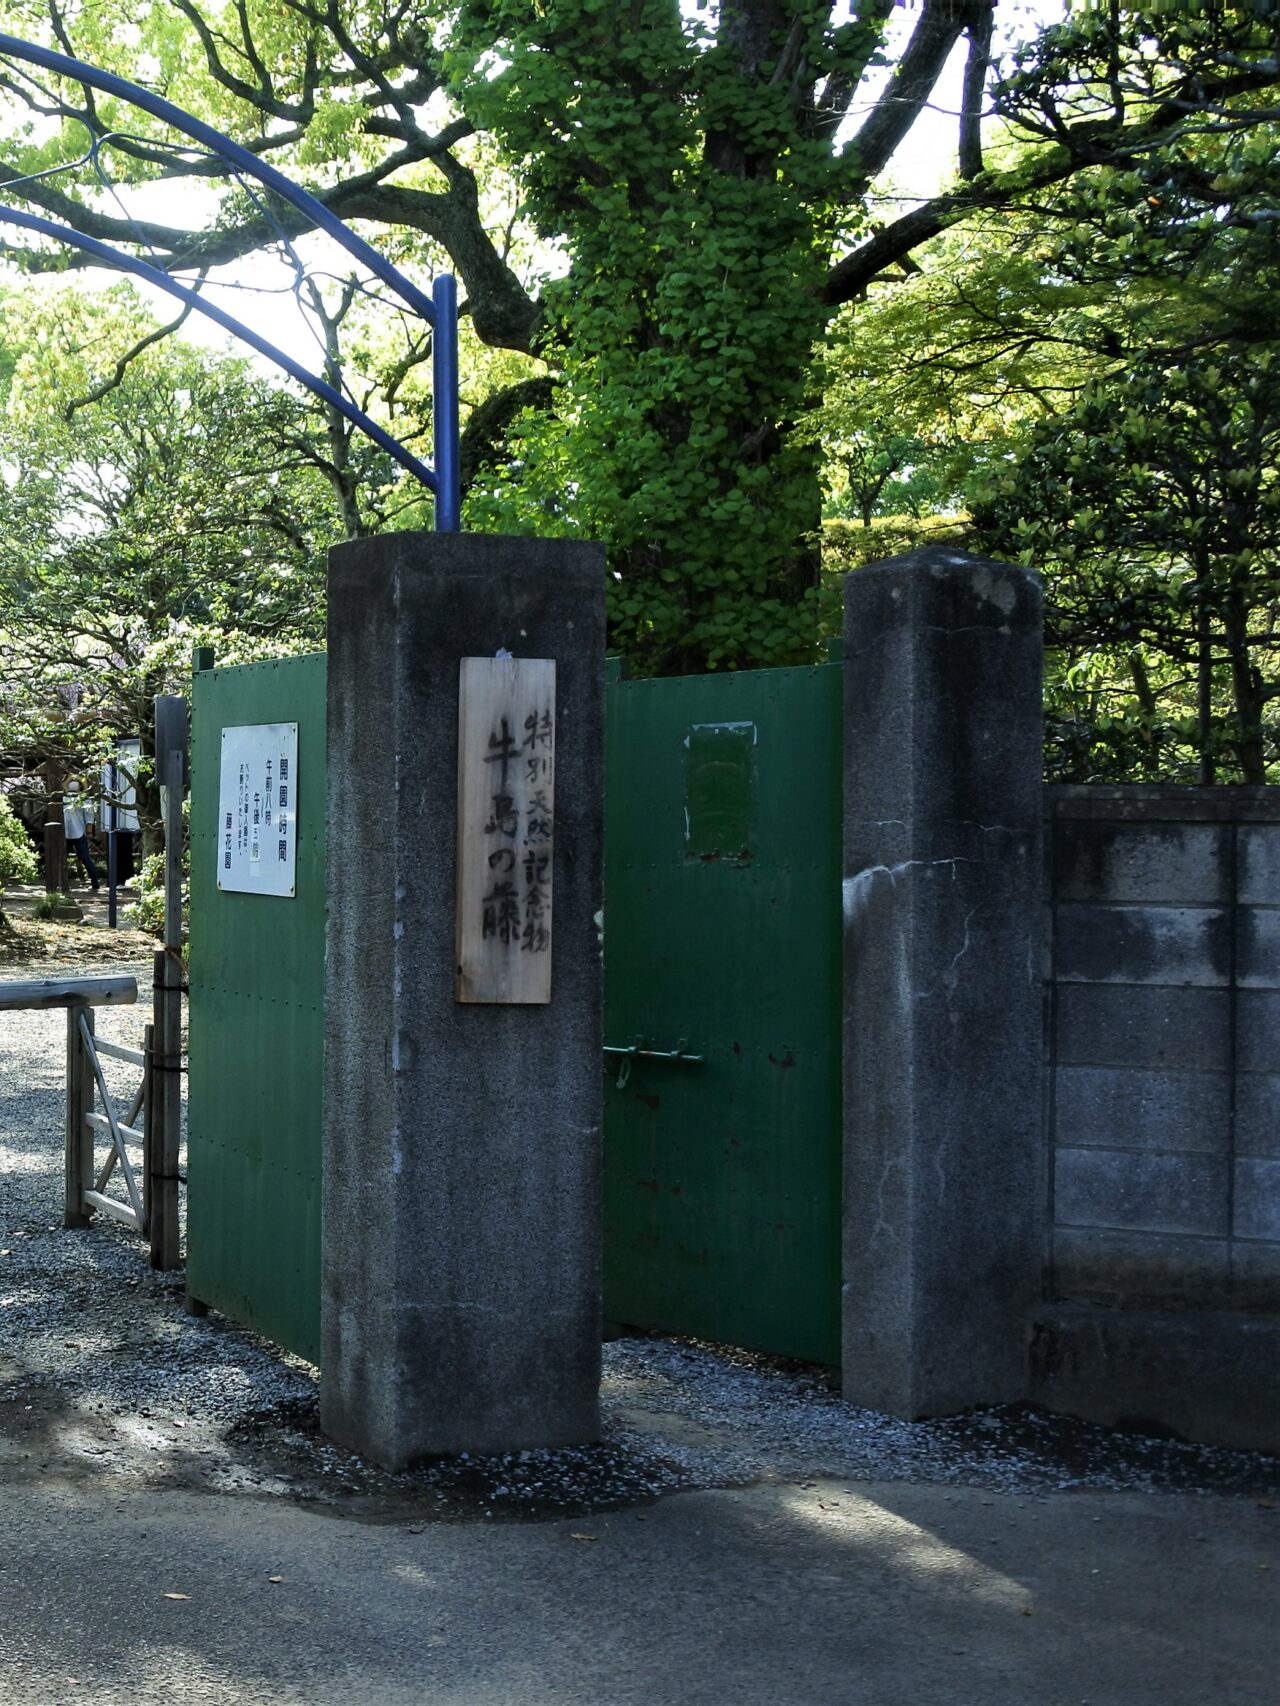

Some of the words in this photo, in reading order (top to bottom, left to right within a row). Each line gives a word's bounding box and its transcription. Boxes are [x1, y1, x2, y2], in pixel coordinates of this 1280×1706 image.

[482, 713, 522, 945] 牛島の藤
[521, 709, 552, 953] 特別天然記念物
